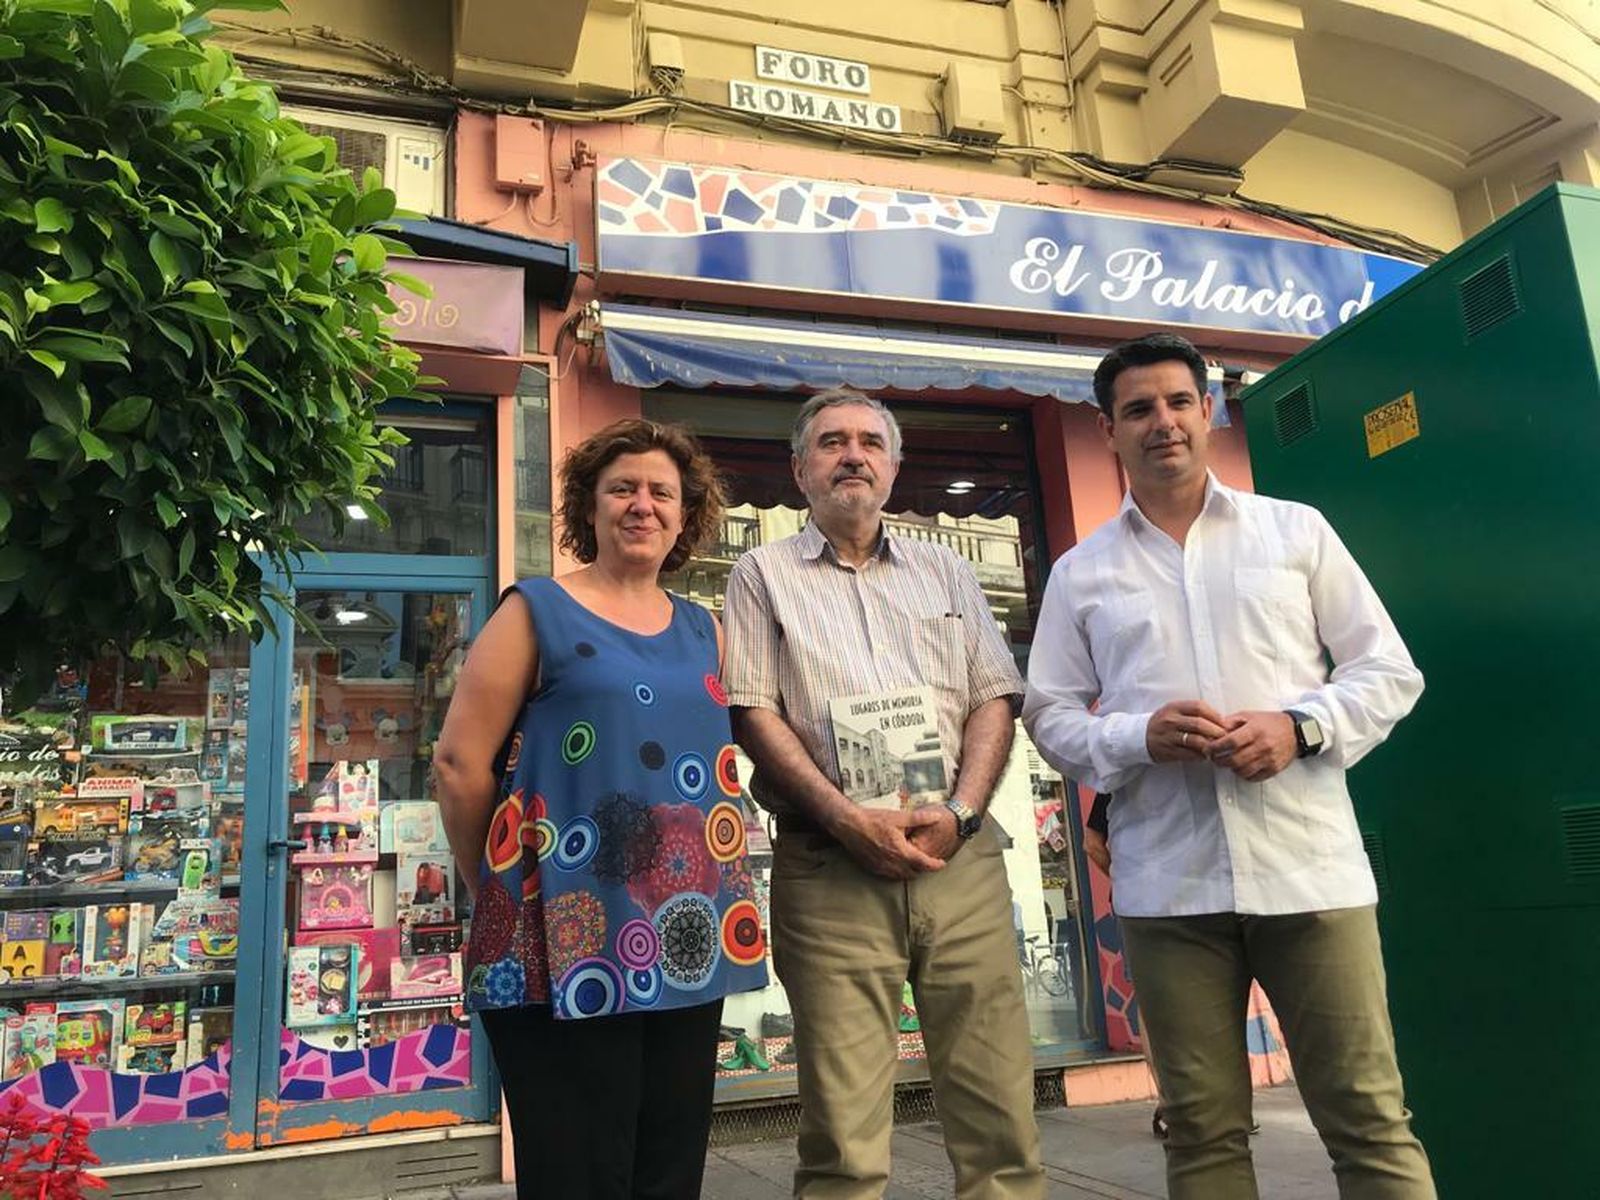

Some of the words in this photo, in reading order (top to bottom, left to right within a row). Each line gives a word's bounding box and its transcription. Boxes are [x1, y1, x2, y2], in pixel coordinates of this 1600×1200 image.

[761, 51, 866, 88] FORO
[734, 83, 897, 130] ROMANO
[1008, 236, 1090, 297] El
[1099, 246, 1327, 322] Palacio
[850, 702, 880, 716] LUGARES
[882, 699, 890, 712] DE
[891, 697, 922, 709] MEMORIA
[880, 718, 890, 731] EN
[892, 713, 925, 728] CÓRDOBA
